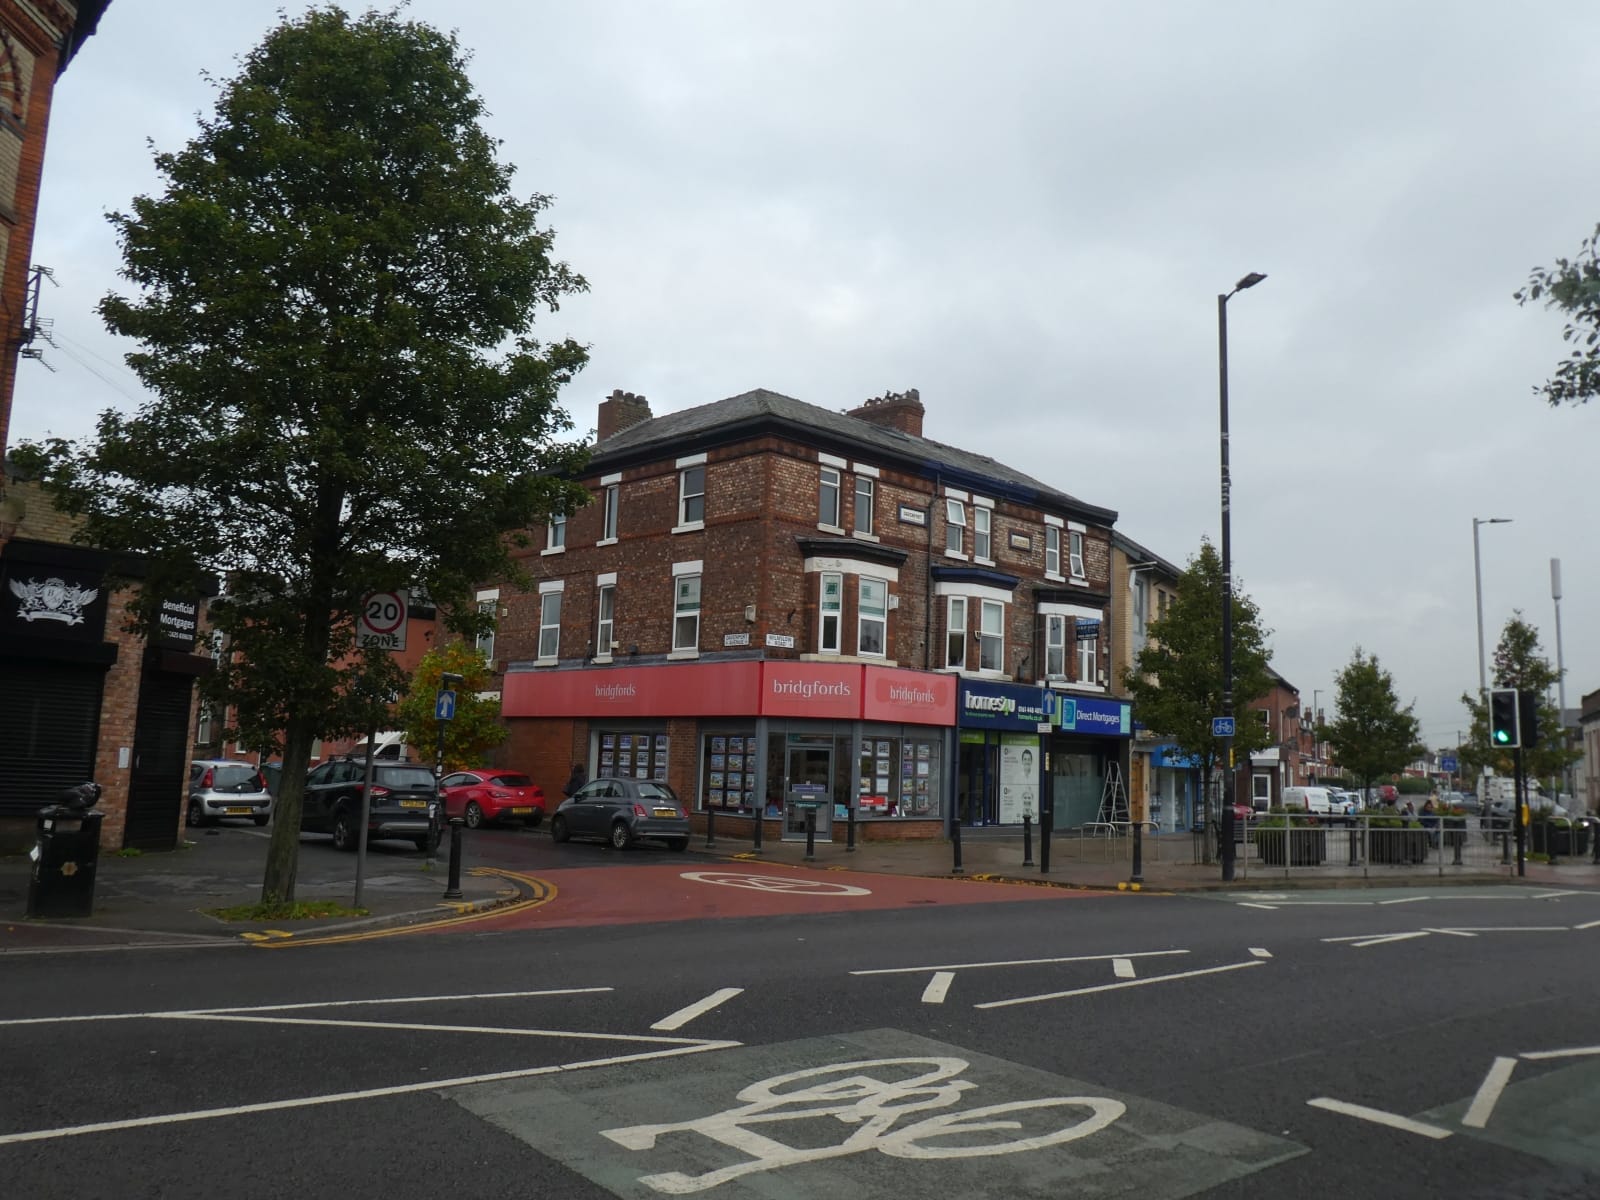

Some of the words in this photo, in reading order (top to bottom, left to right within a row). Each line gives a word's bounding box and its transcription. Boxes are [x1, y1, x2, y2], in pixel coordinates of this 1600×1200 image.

[163, 600, 194, 615] Beneficial
[369, 602, 398, 621] 20
[160, 613, 194, 630] Mortgages
[361, 634, 399, 647] ZONE
[595, 683, 636, 700] bridgfords
[773, 679, 851, 698] bridgfords
[890, 685, 935, 703] bridgfords
[1076, 709, 1092, 721] Direct
[1092, 711, 1120, 725] Mortgages
